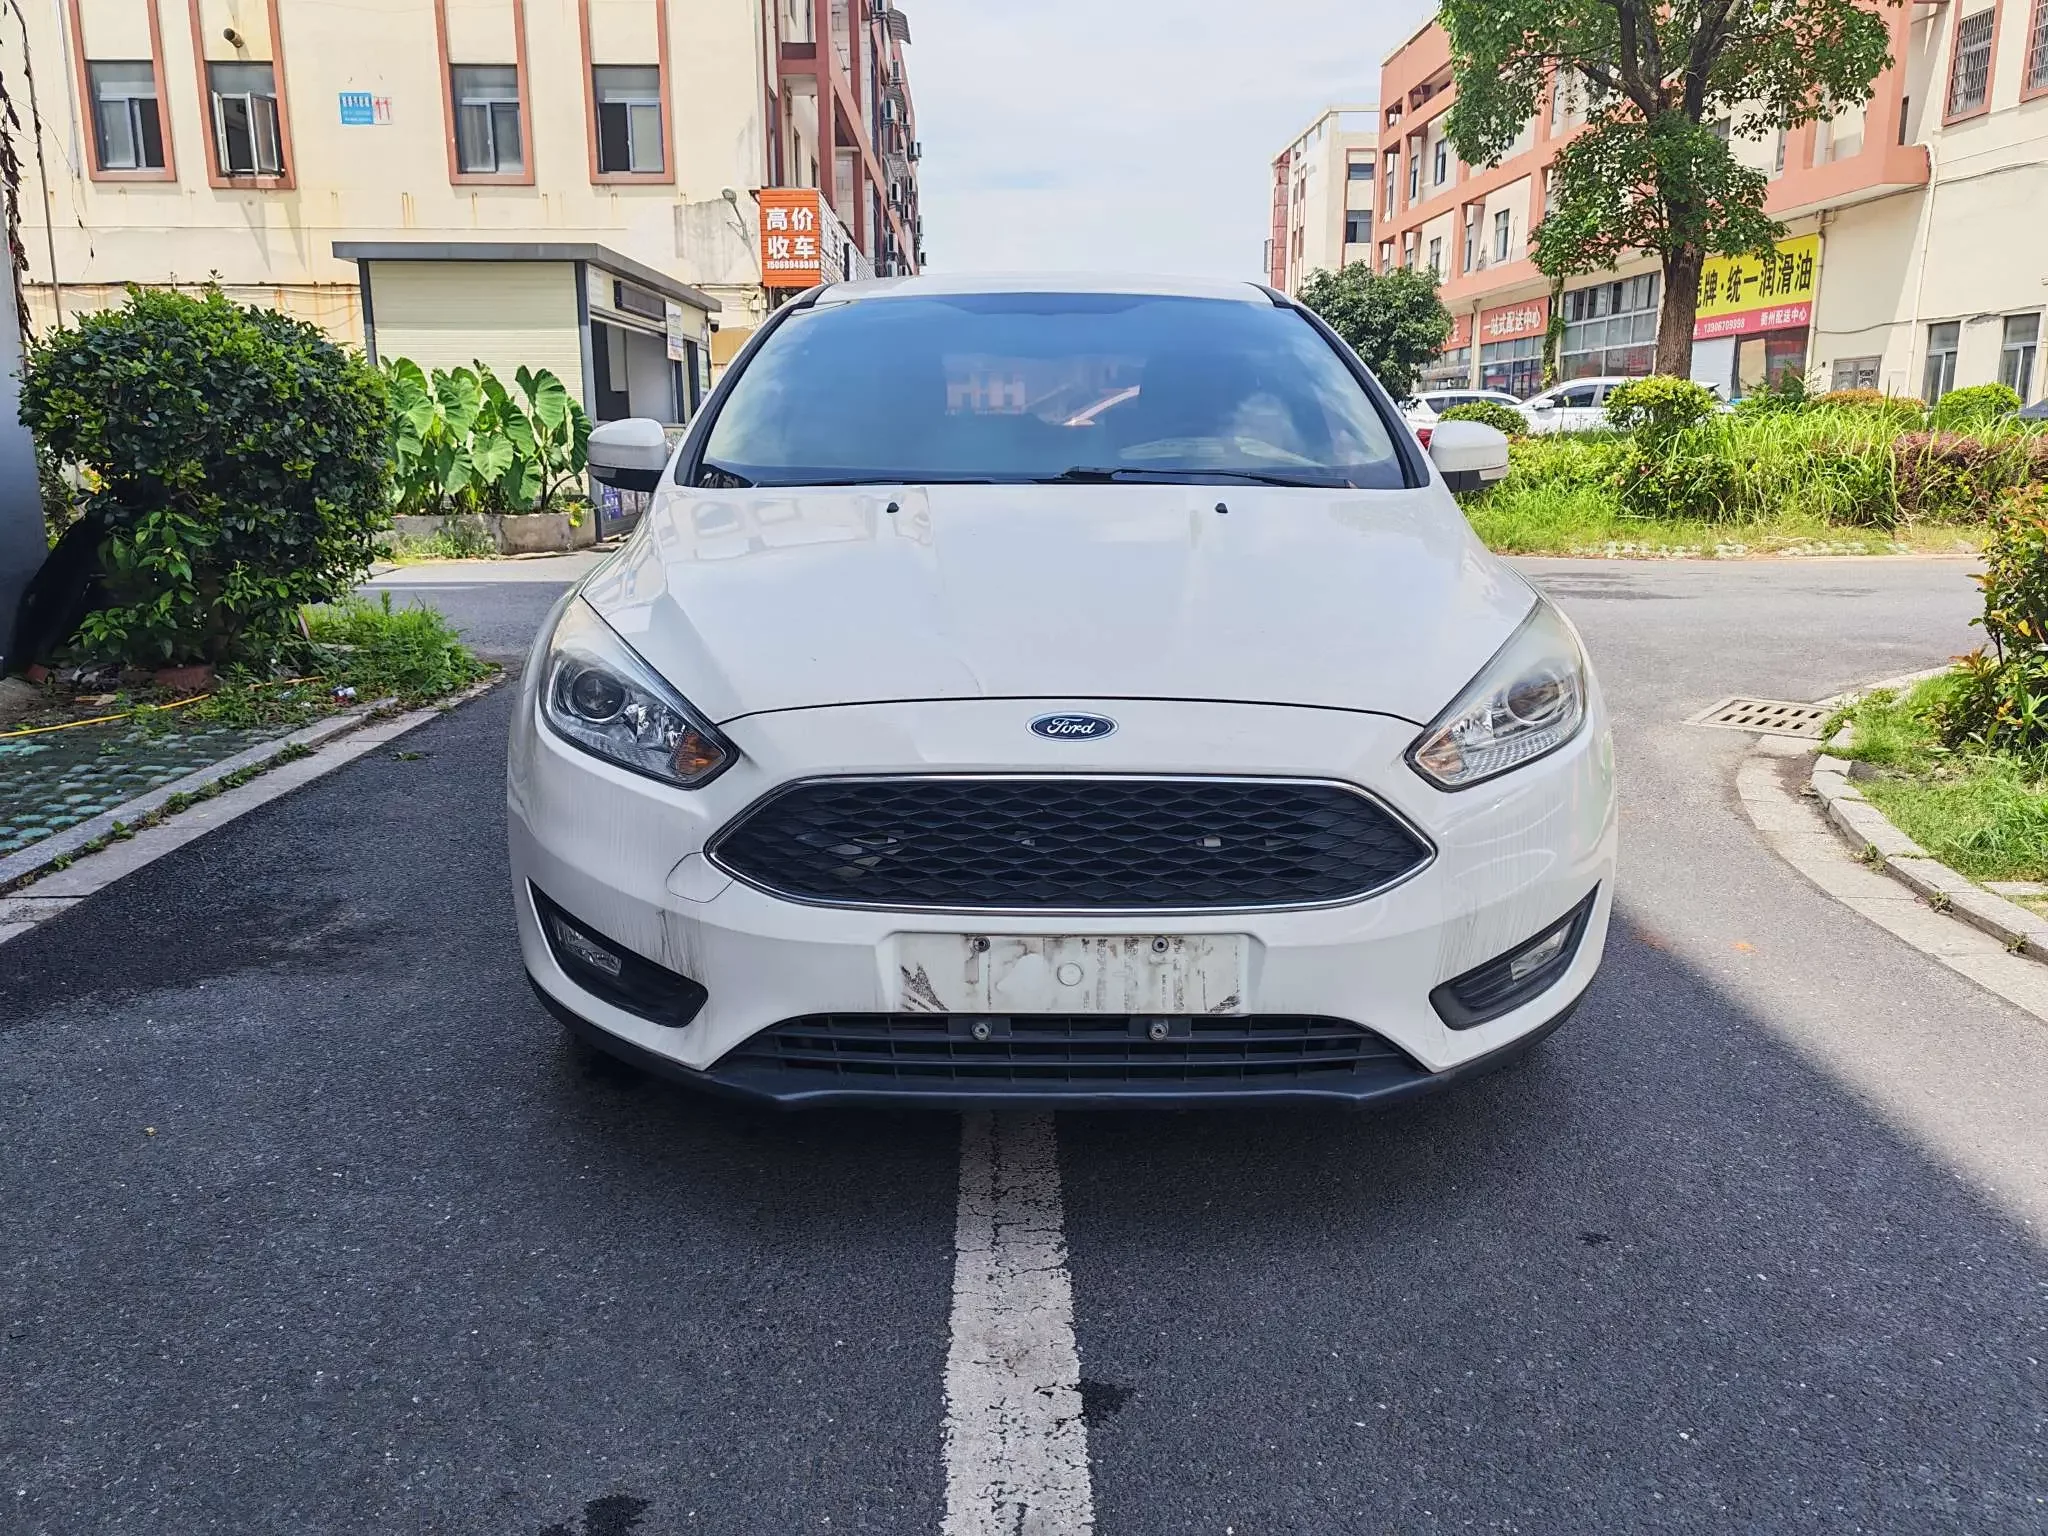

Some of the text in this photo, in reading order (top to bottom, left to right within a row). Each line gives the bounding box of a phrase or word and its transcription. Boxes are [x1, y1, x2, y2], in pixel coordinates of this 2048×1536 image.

[766, 207, 814, 231] 高价
[767, 236, 817, 259] 收车
[1046, 717, 1096, 734] Ford
